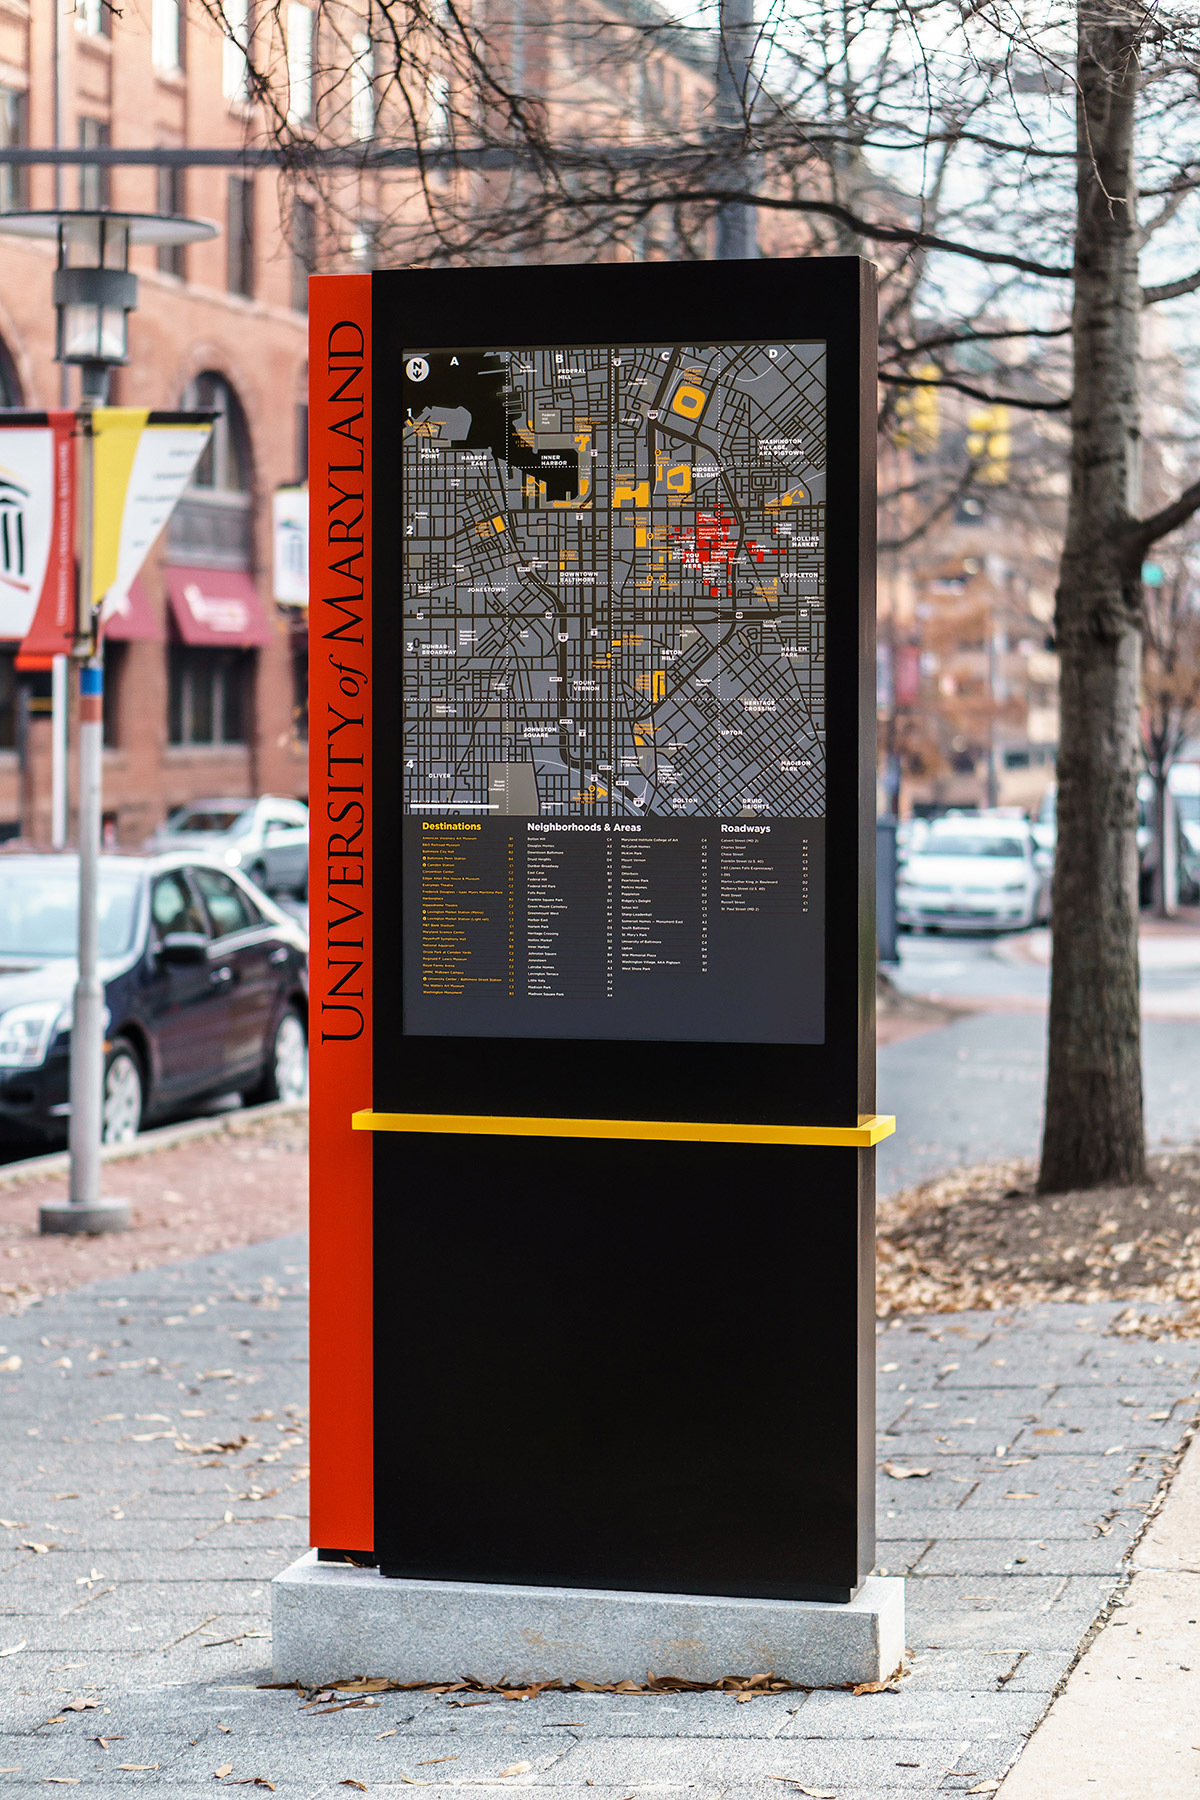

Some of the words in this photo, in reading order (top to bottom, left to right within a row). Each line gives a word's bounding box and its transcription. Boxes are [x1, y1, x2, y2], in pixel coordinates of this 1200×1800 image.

[661, 352, 670, 361] C
[768, 349, 778, 358] D
[450, 356, 459, 366] A
[555, 354, 564, 364] B
[413, 361, 422, 370] N
[406, 408, 412, 417] 1
[321, 320, 365, 647] MARYLAND
[406, 526, 413, 534] 2
[406, 642, 414, 652] 3
[328, 653, 369, 698] of
[406, 760, 414, 769] 4
[422, 822, 482, 831] Destinations
[527, 823, 602, 833] Neighborhoods
[613, 824, 642, 832] Areas
[721, 824, 771, 834] Roadways
[322, 702, 365, 1045] UNIVERSITY
